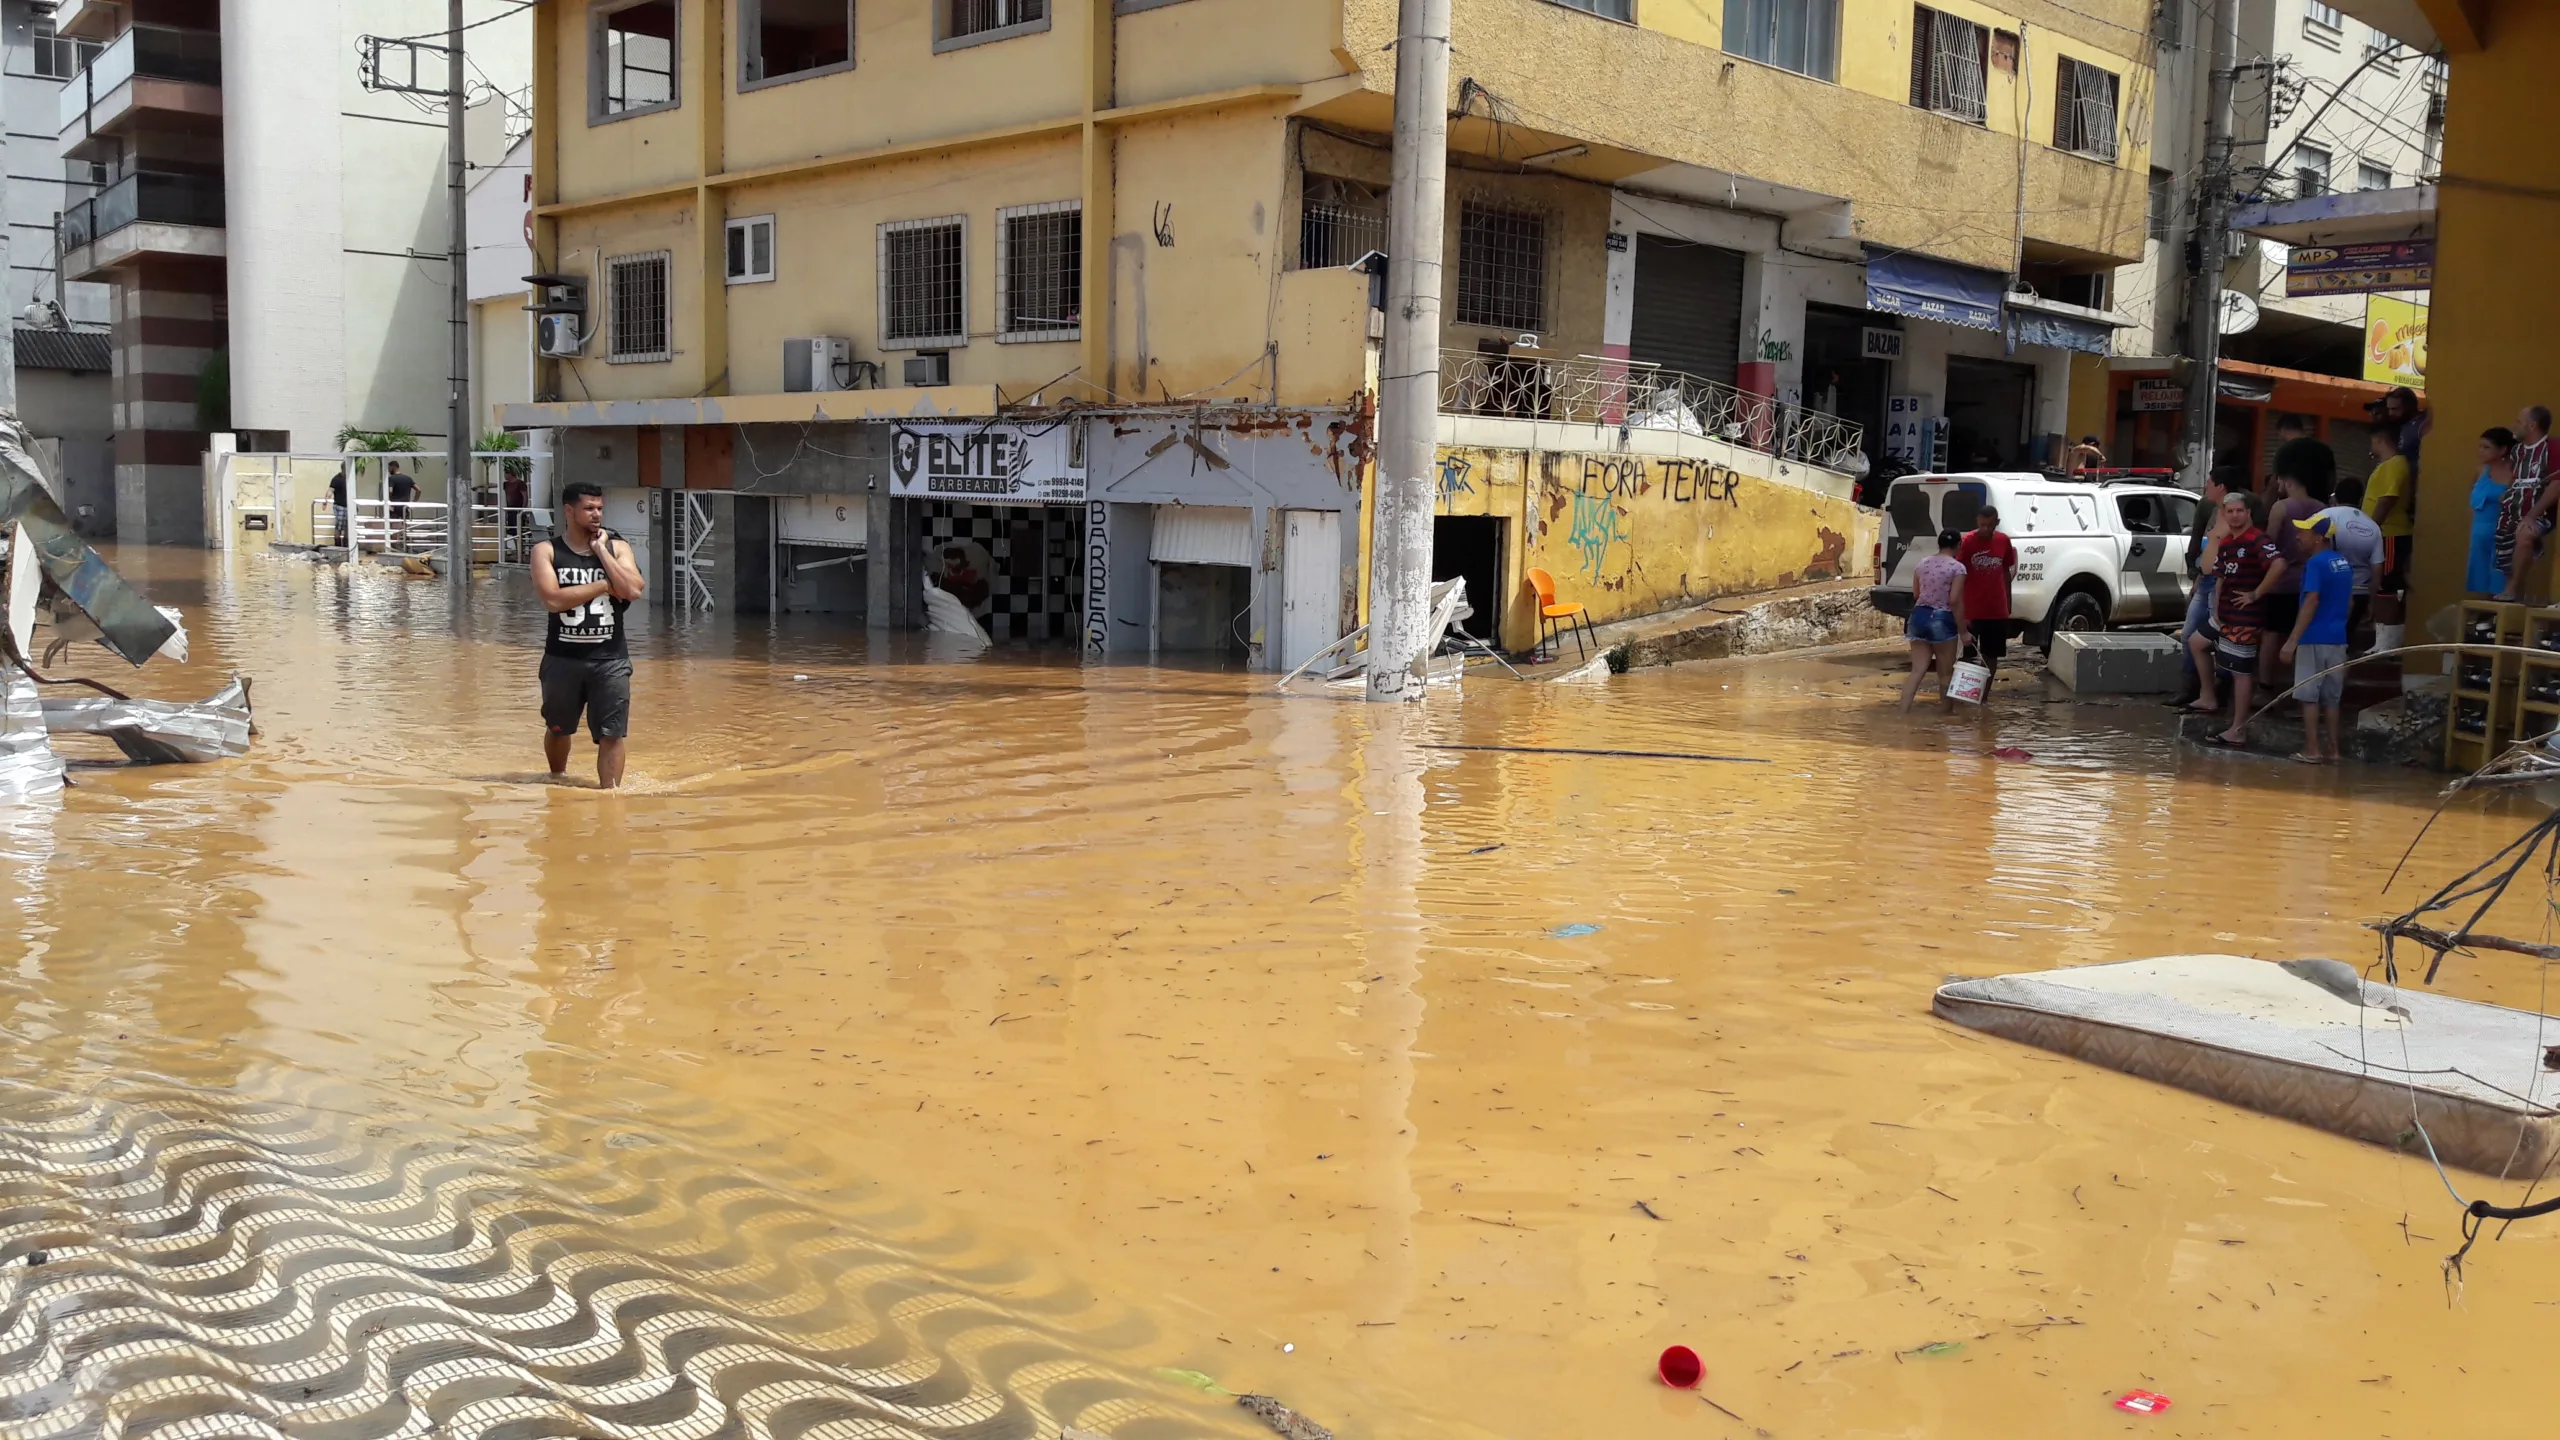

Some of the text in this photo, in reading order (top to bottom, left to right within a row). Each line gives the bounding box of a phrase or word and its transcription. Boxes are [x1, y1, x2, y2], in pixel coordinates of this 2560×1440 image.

[2298, 250, 2333, 262] MPS
[1876, 294, 1901, 307] BAZAR
[1921, 301, 1945, 313] BAZAR
[1968, 310, 1992, 323] BAZAR
[1867, 332, 1900, 356] BAZAR
[928, 433, 1008, 476] ELITE
[931, 479, 1005, 493] BARBEARIA
[1582, 458, 1739, 507] FORA TEMER
[2019, 563, 2044, 571] RP 3539
[2016, 573, 2044, 581] CPO SUL
[559, 626, 614, 636] SNEAKERS
